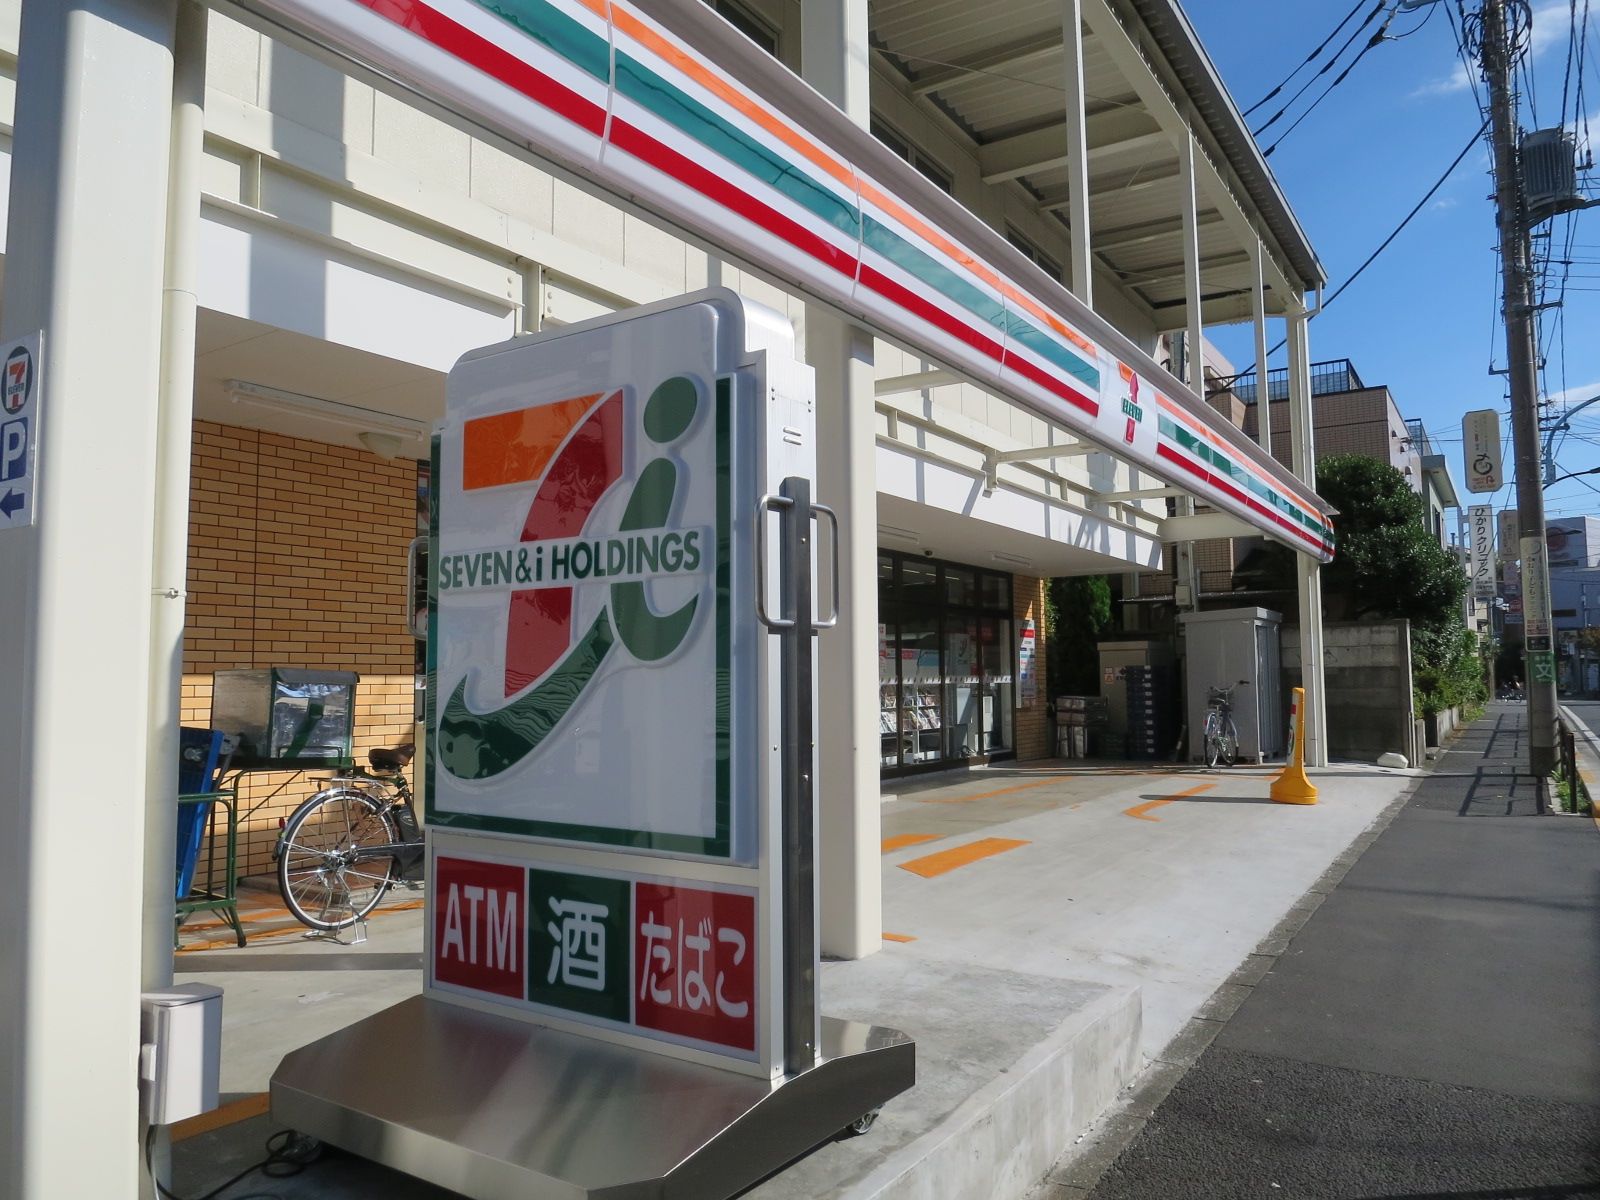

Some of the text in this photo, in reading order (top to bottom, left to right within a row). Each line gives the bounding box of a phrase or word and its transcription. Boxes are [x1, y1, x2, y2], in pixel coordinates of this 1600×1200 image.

[2, 421, 26, 480] P
[551, 530, 700, 580] HOLDINGS
[1475, 507, 1489, 577] ひかりクリニック
[441, 882, 518, 974] ATM
[547, 896, 609, 992] 酒
[640, 910, 749, 1019] たばこ
